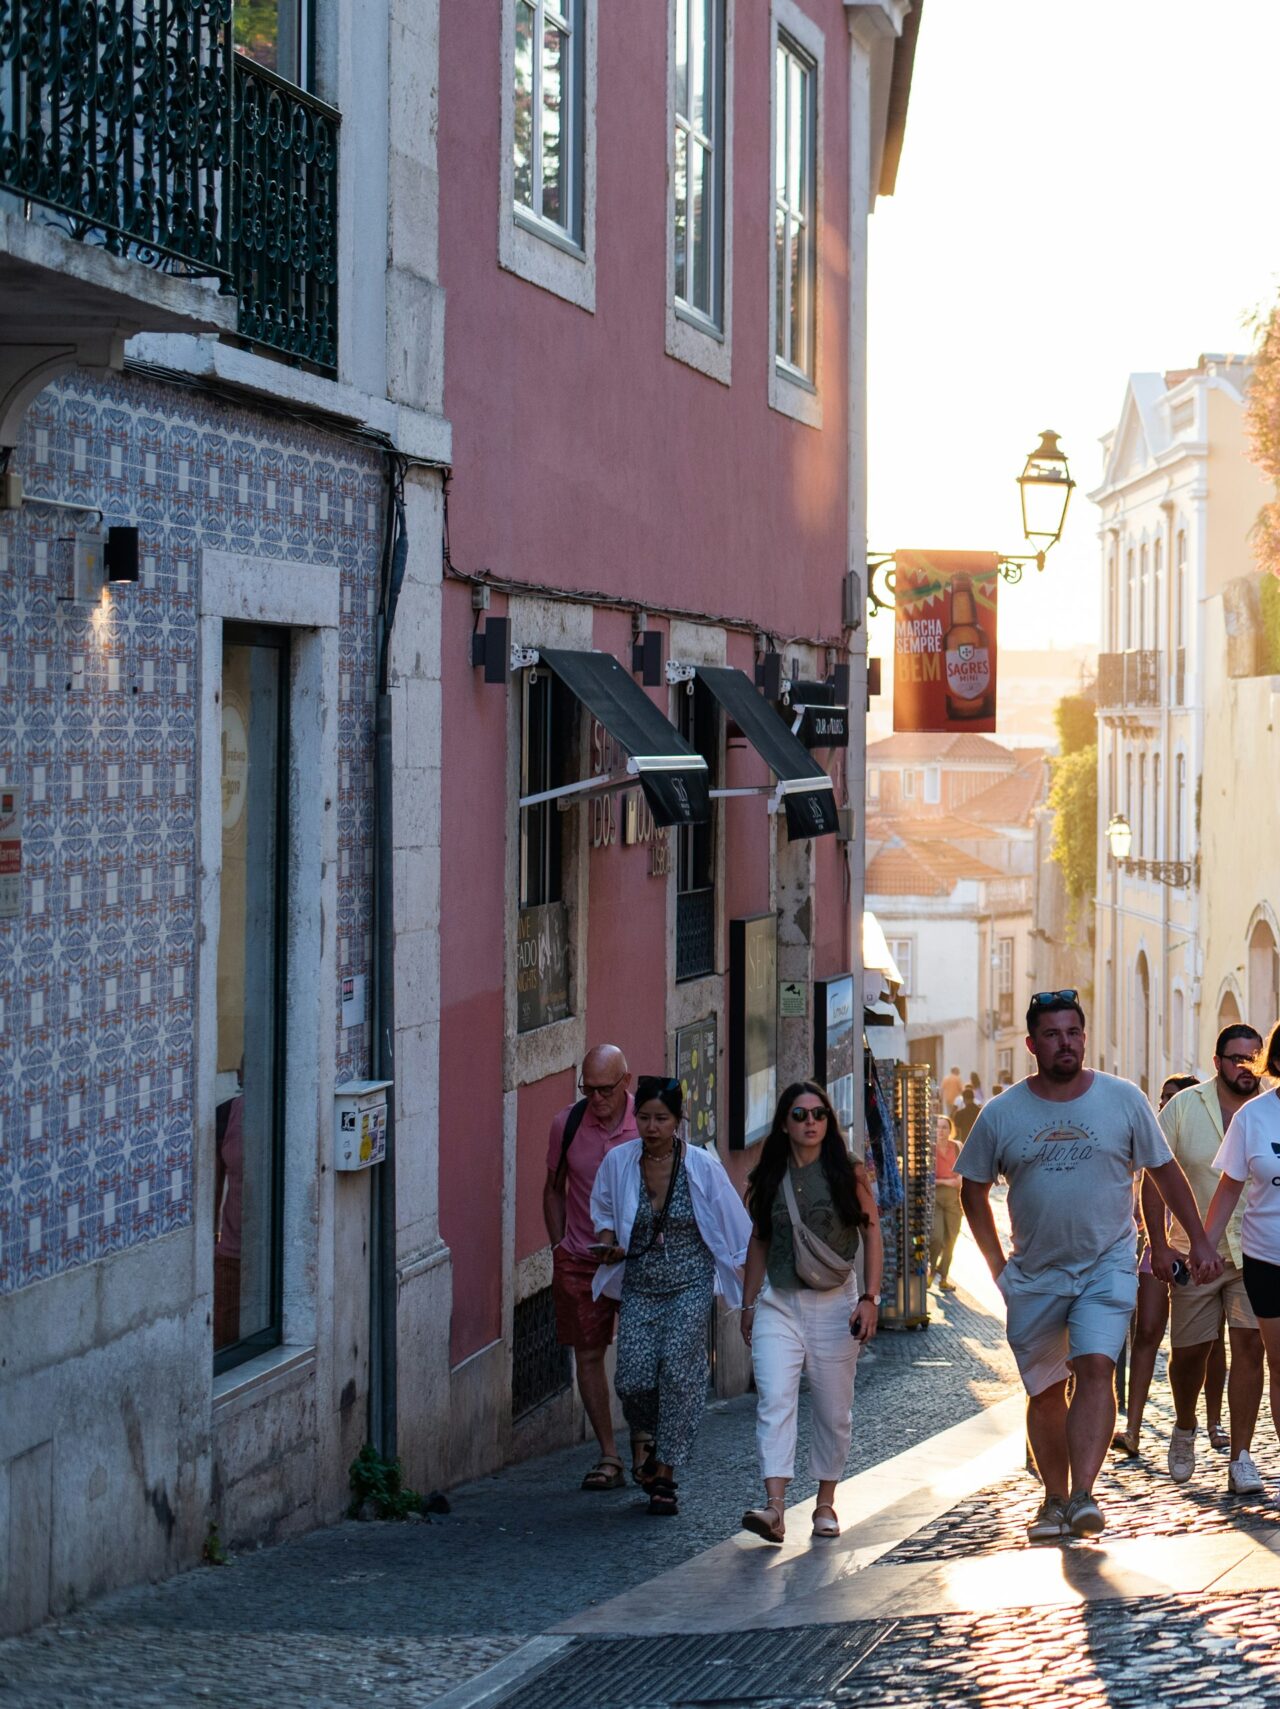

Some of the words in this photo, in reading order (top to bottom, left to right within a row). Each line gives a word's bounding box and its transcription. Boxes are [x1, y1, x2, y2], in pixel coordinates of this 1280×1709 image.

[896, 619, 943, 638] MARCHA
[897, 637, 942, 654] SEMPRE
[899, 654, 941, 682] BEM
[948, 661, 989, 677] SAGRES
[518, 916, 531, 940] IVE
[517, 969, 537, 993] NIGHTS
[1022, 1140, 1094, 1164] Aloha
